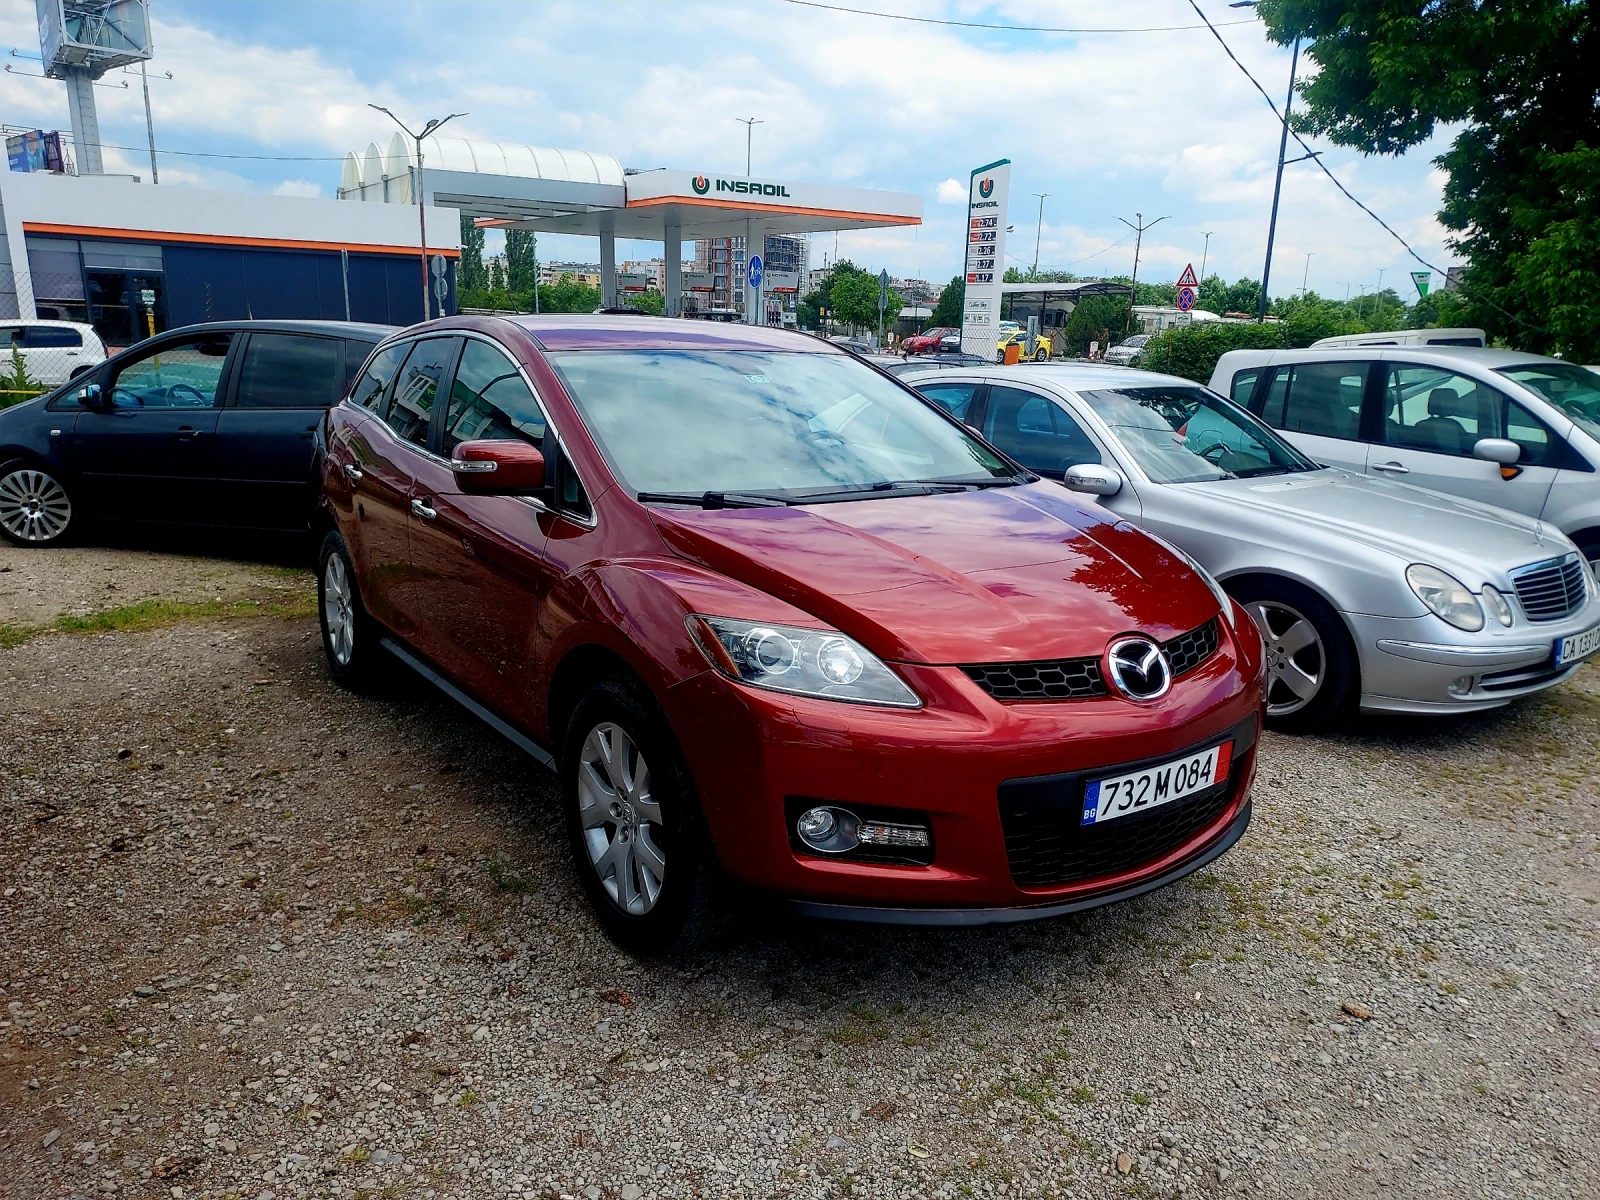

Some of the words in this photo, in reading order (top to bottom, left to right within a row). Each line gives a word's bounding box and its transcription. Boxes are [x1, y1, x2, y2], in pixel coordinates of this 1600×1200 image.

[716, 179, 790, 197] INSAOIL
[971, 201, 998, 209] INSAOIL
[1101, 776, 1151, 816] 732
[1154, 767, 1171, 801] M
[1174, 753, 1213, 794] 084
[1083, 808, 1097, 820] BG
